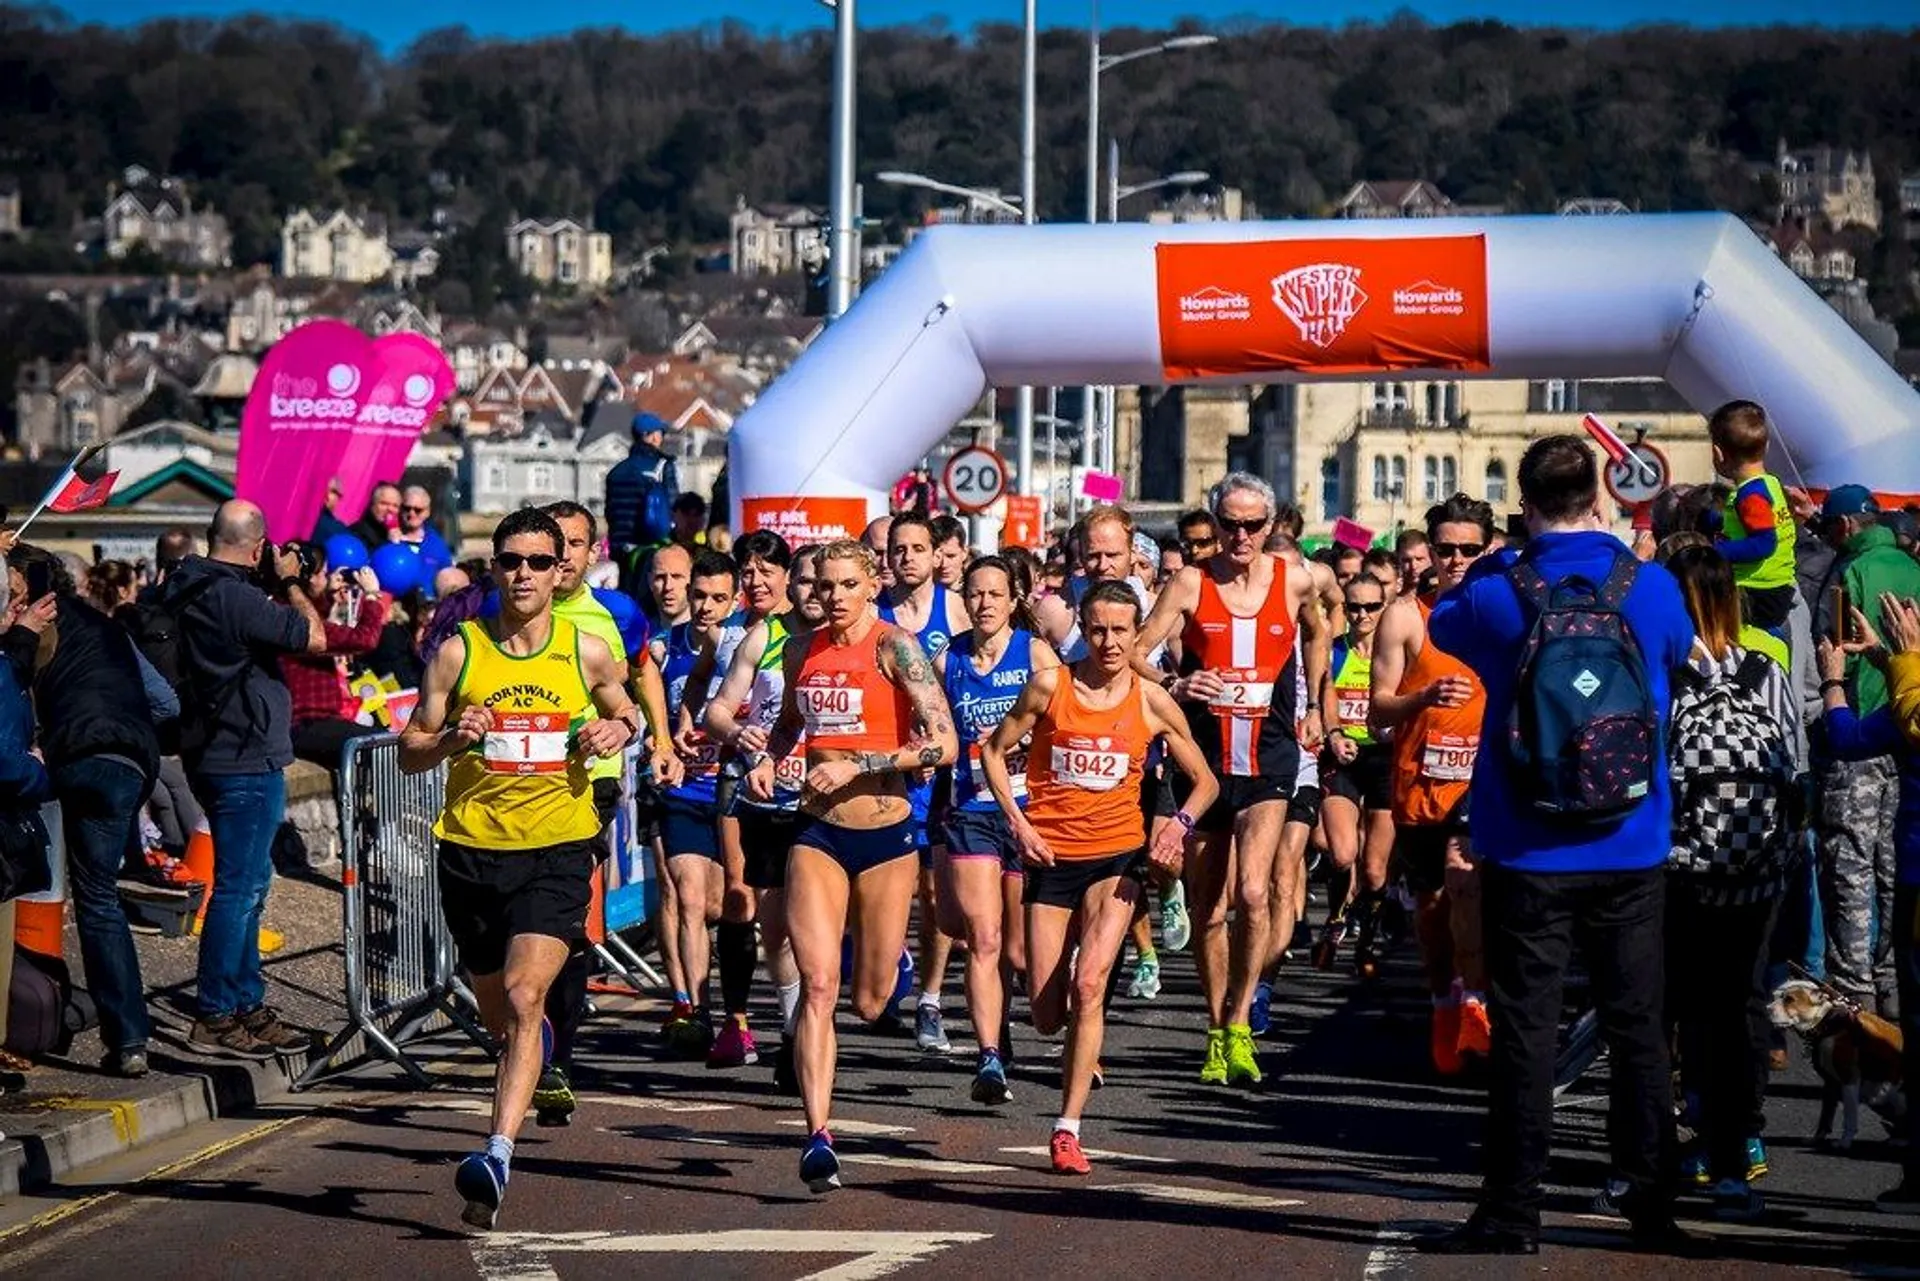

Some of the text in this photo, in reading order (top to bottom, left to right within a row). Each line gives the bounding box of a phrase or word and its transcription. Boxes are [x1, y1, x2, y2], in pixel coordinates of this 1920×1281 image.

[1180, 294, 1250, 311] Howards
[1281, 279, 1353, 316] SUPER
[1394, 288, 1463, 303] Howards
[1182, 310, 1250, 321] Motor Group
[1394, 305, 1463, 316] Motor Group
[270, 393, 358, 418] breeze
[357, 403, 428, 426] reeze
[955, 466, 997, 492] 20
[1616, 461, 1660, 488] 20
[992, 669, 1028, 687] RAINEY
[484, 684, 562, 708] CORNWALL
[512, 698, 533, 708] AC
[802, 690, 849, 713] 1940
[1233, 685, 1246, 704] 2
[520, 735, 531, 758] 1
[1063, 751, 1116, 776] 1942
